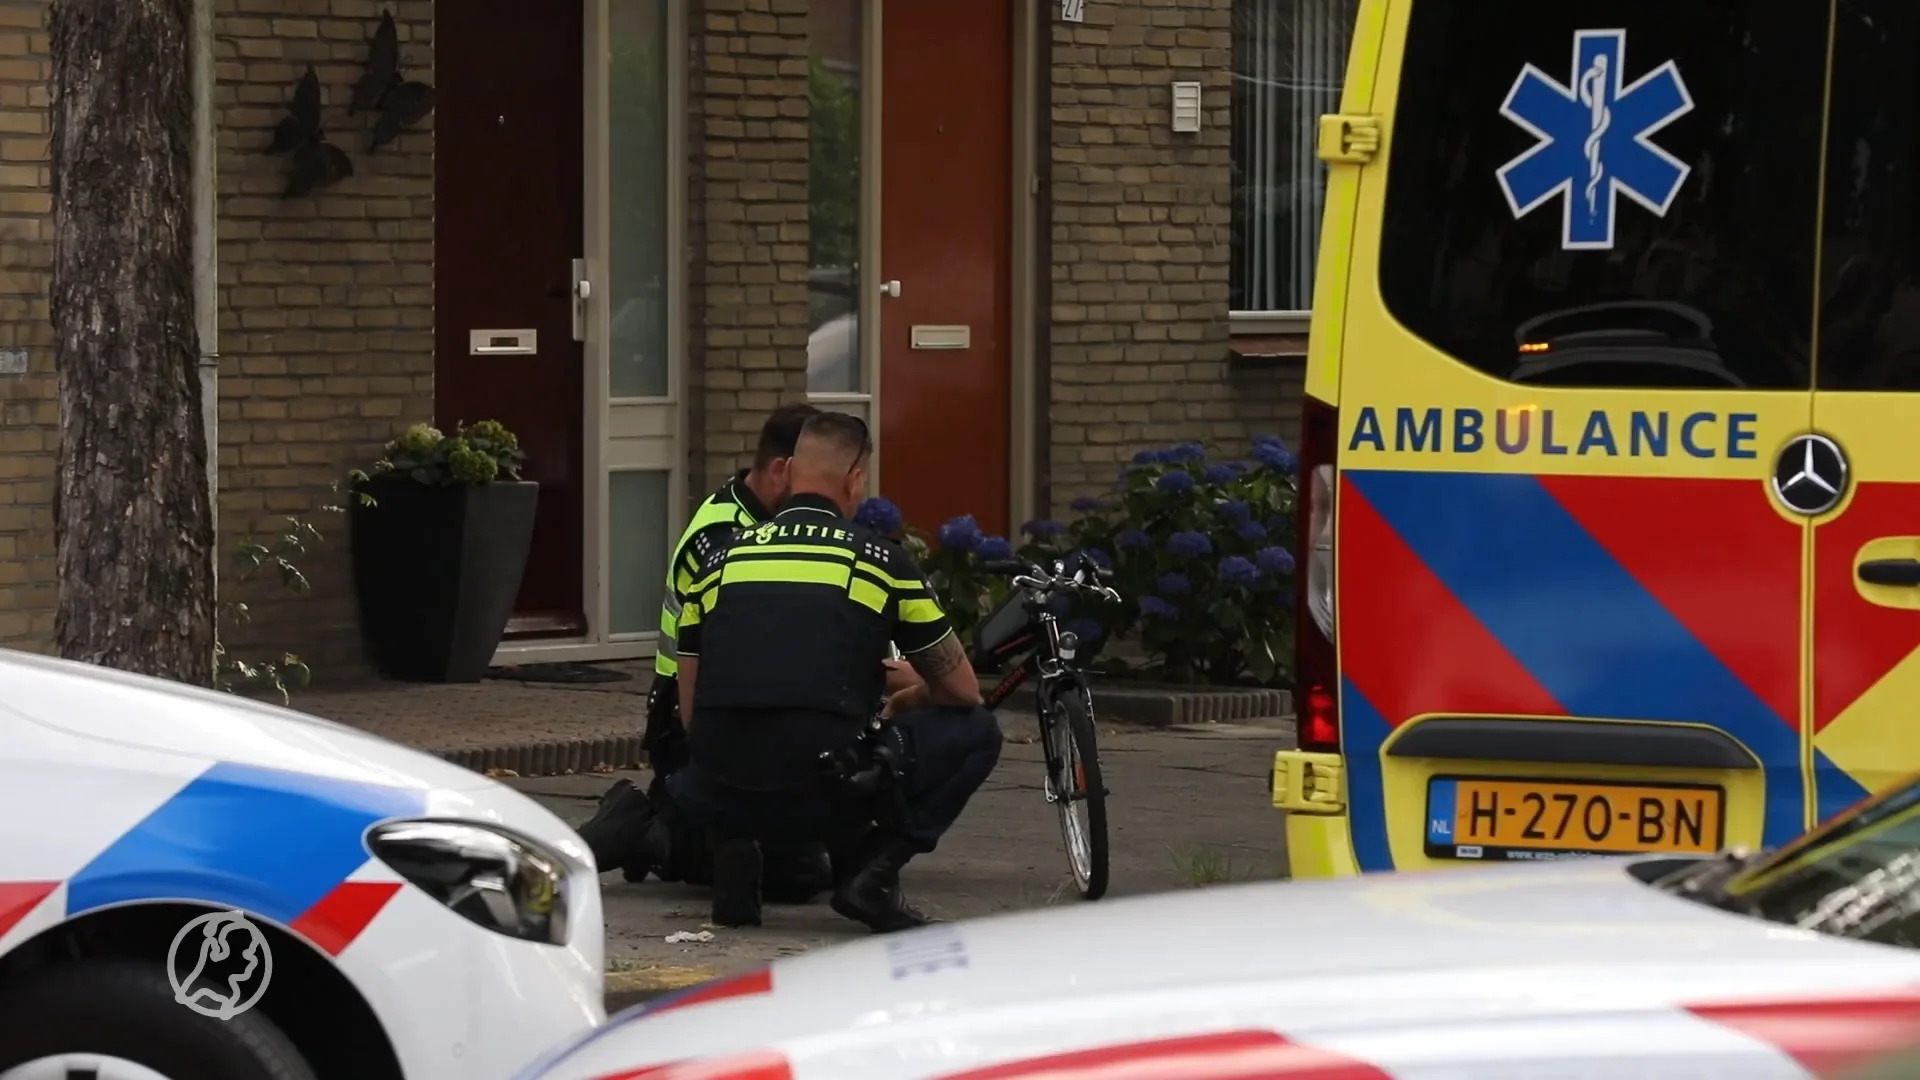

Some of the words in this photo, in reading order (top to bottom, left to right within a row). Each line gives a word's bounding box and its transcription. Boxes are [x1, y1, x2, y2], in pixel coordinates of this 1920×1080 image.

[1348, 406, 1758, 459] AMBULANCE
[741, 522, 847, 545] POLITIE
[1432, 818, 1450, 834] NL
[1469, 790, 1704, 846] H-270-BN
